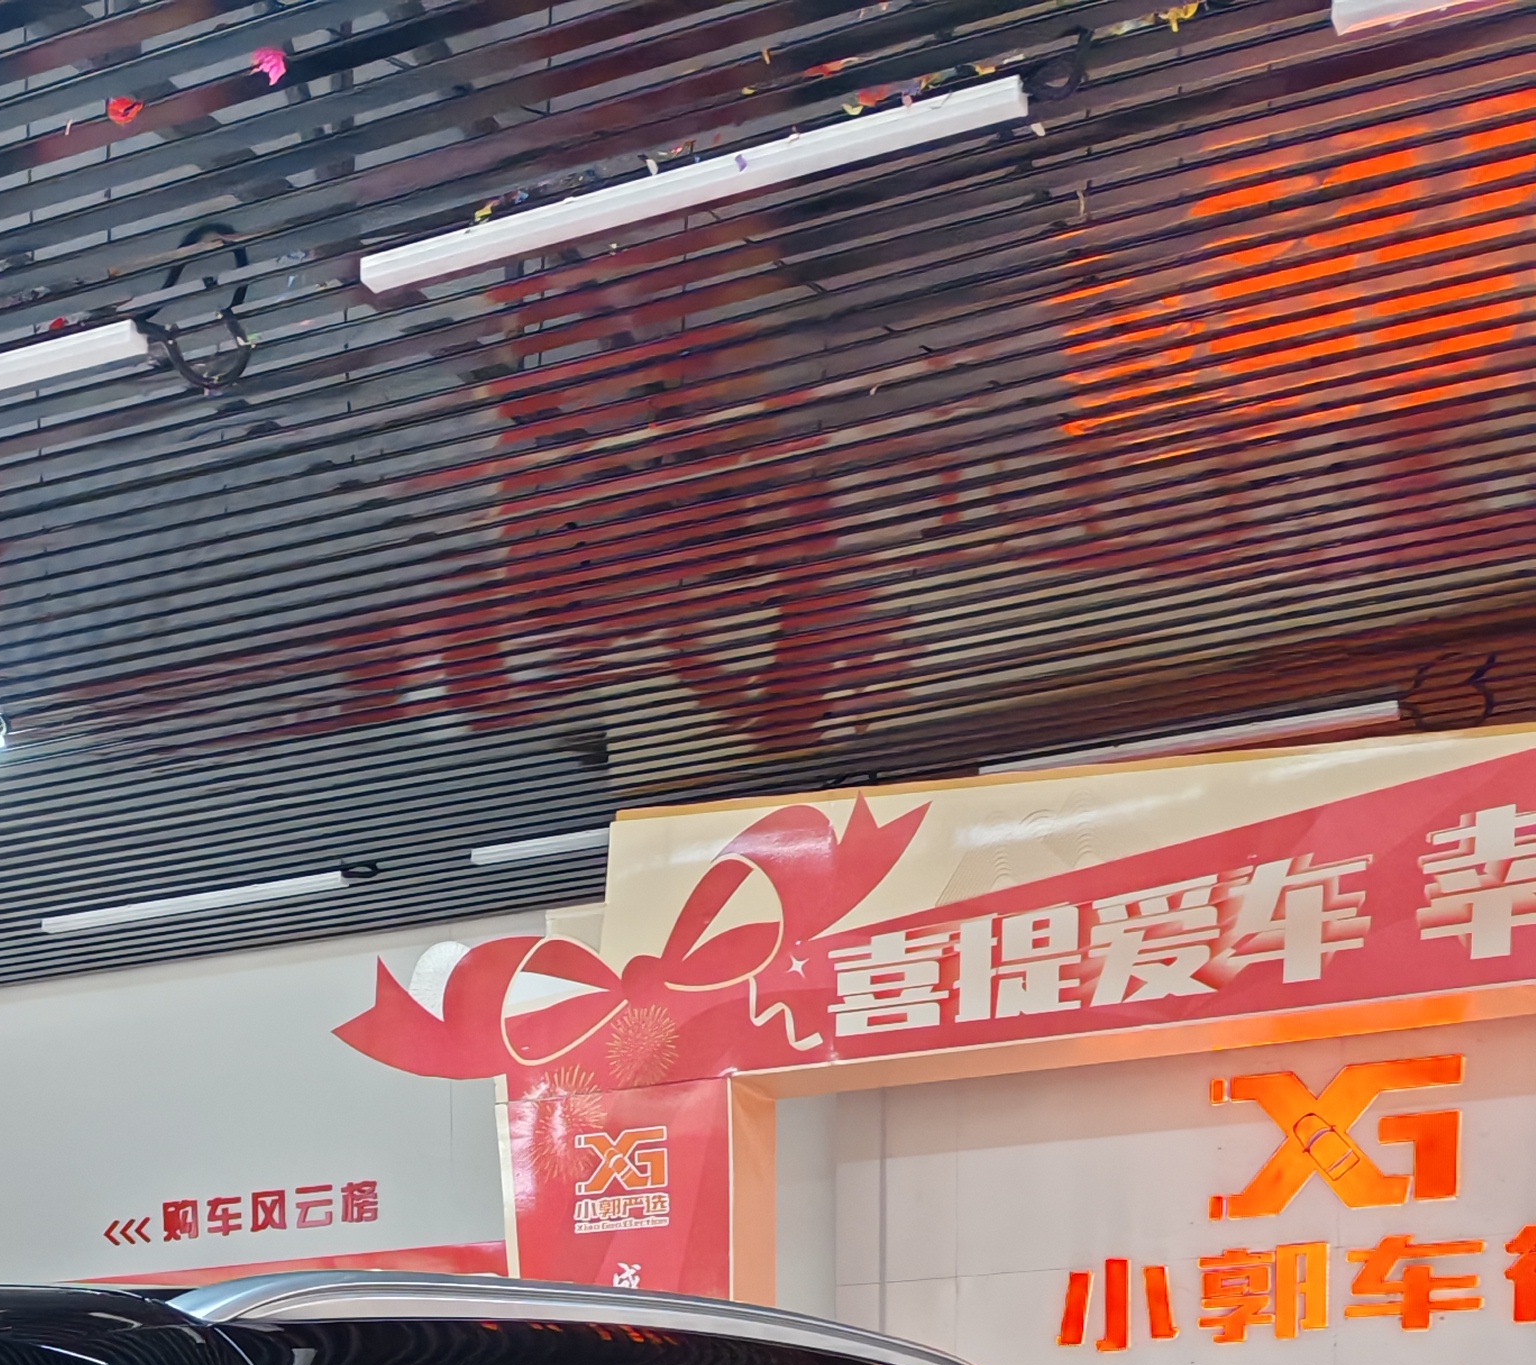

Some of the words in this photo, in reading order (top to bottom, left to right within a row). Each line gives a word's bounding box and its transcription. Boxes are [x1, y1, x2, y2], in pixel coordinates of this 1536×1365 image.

[827, 853, 1372, 1037] 喜提爱车
[575, 1126, 667, 1195] XG
[1209, 1054, 1464, 1220] XG
[163, 1180, 379, 1242] 购车风云榜
[574, 1195, 670, 1221] 小郭严选
[1057, 1225, 1536, 1352] 小郭车
